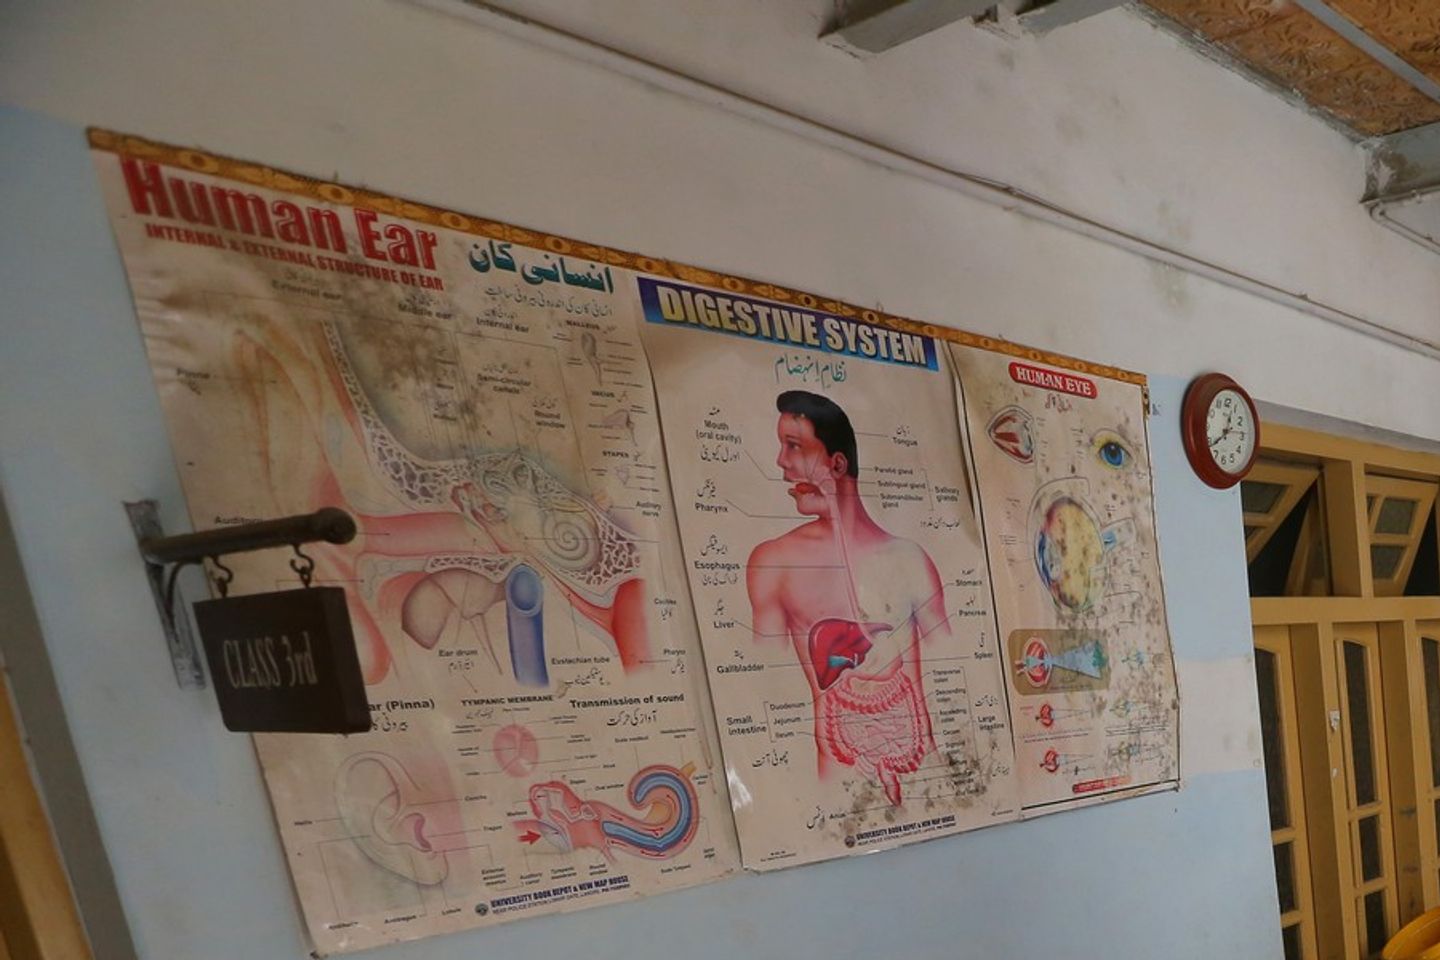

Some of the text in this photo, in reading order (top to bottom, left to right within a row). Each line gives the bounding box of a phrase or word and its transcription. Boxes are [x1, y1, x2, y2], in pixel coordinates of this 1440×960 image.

[121, 155, 438, 271] Human Ear
[468, 240, 516, 272] کان
[317, 255, 398, 283] STRUCTURE
[400, 271, 416, 287] OF
[418, 274, 444, 291] EAR
[656, 285, 927, 365] DIGESTIVE SYSTEM
[1015, 366, 1092, 396] HUMAN EYE
[703, 419, 729, 431] Mouth
[892, 436, 919, 447] Tongue
[694, 502, 729, 514] Pharynx
[693, 560, 741, 572] Esophagus
[713, 620, 735, 629] Liver
[223, 630, 319, 690] CLASS 3rd
[385, 697, 435, 713] (Pinna)
[569, 692, 685, 709] Transmission of sound
[726, 715, 753, 726] Small
[490, 891, 533, 908] UNIVERSITY
